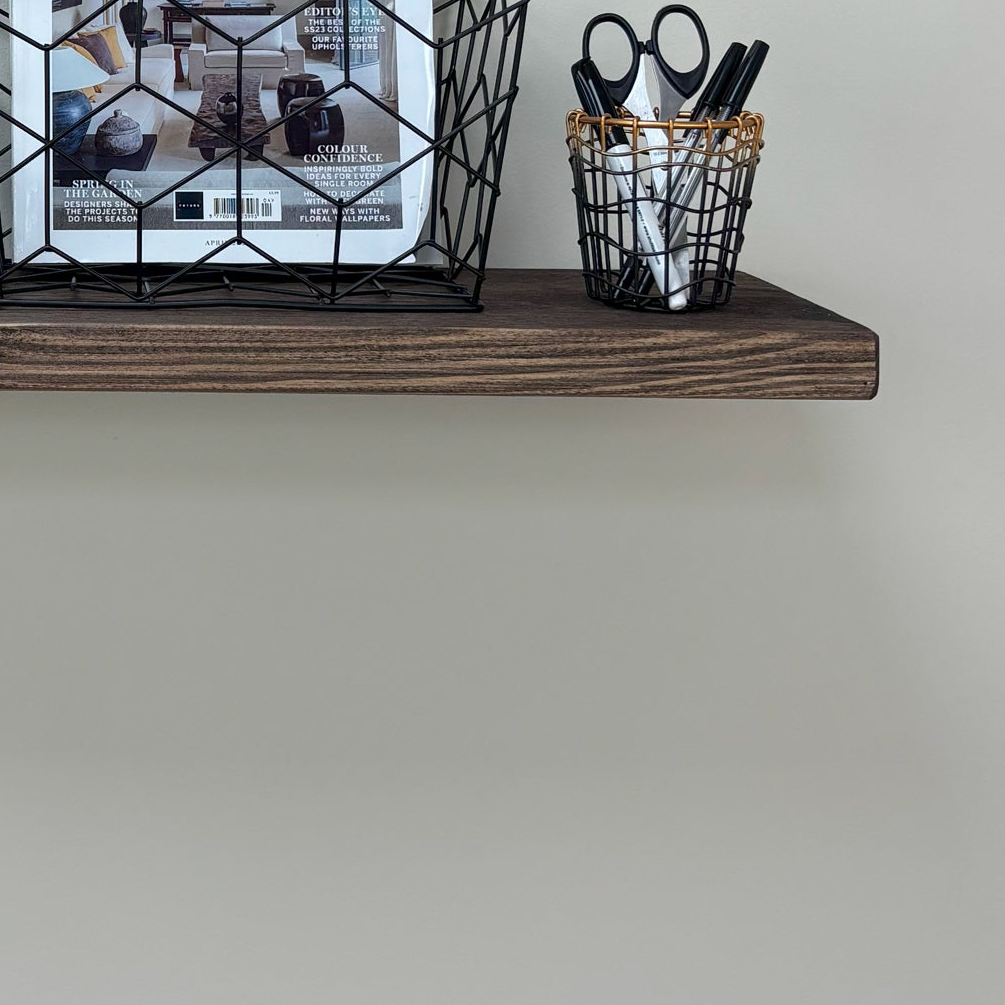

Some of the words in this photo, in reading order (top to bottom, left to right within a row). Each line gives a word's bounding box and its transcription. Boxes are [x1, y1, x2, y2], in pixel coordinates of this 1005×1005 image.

[304, 7, 360, 16] EDITO'S
[317, 144, 368, 154] COLOUR
[303, 153, 384, 163] CONFIDENCE
[353, 172, 381, 180] EVERY
[72, 179, 117, 189] SPRIG
[120, 179, 134, 189] IN
[63, 189, 90, 198] THE
[115, 200, 135, 208] SHA
[305, 197, 327, 205] WITH
[299, 215, 332, 223] FLORAL
